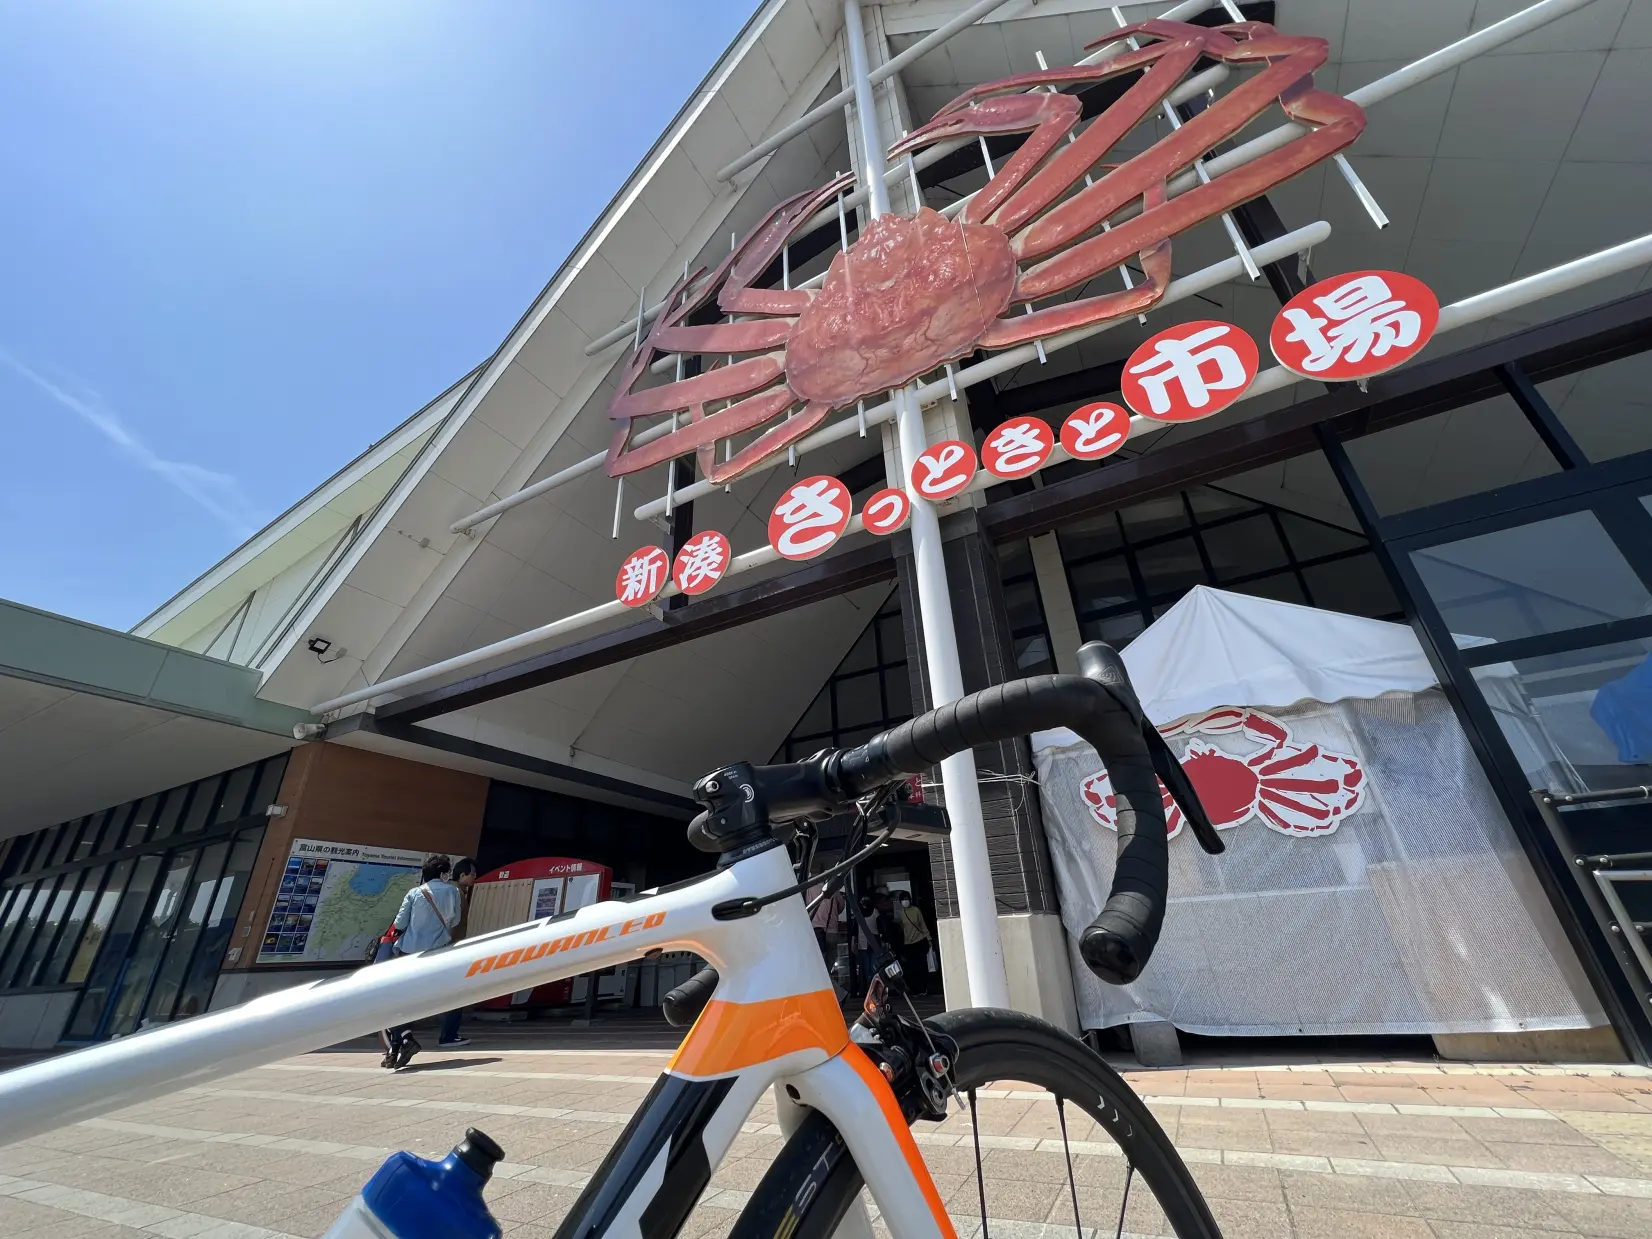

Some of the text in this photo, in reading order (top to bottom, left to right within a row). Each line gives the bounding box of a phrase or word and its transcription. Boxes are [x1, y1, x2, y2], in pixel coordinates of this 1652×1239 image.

[299, 844, 360, 857] 富山県の観光案内
[549, 863, 583, 874] イベント情報
[464, 911, 668, 978] ADVANCED
